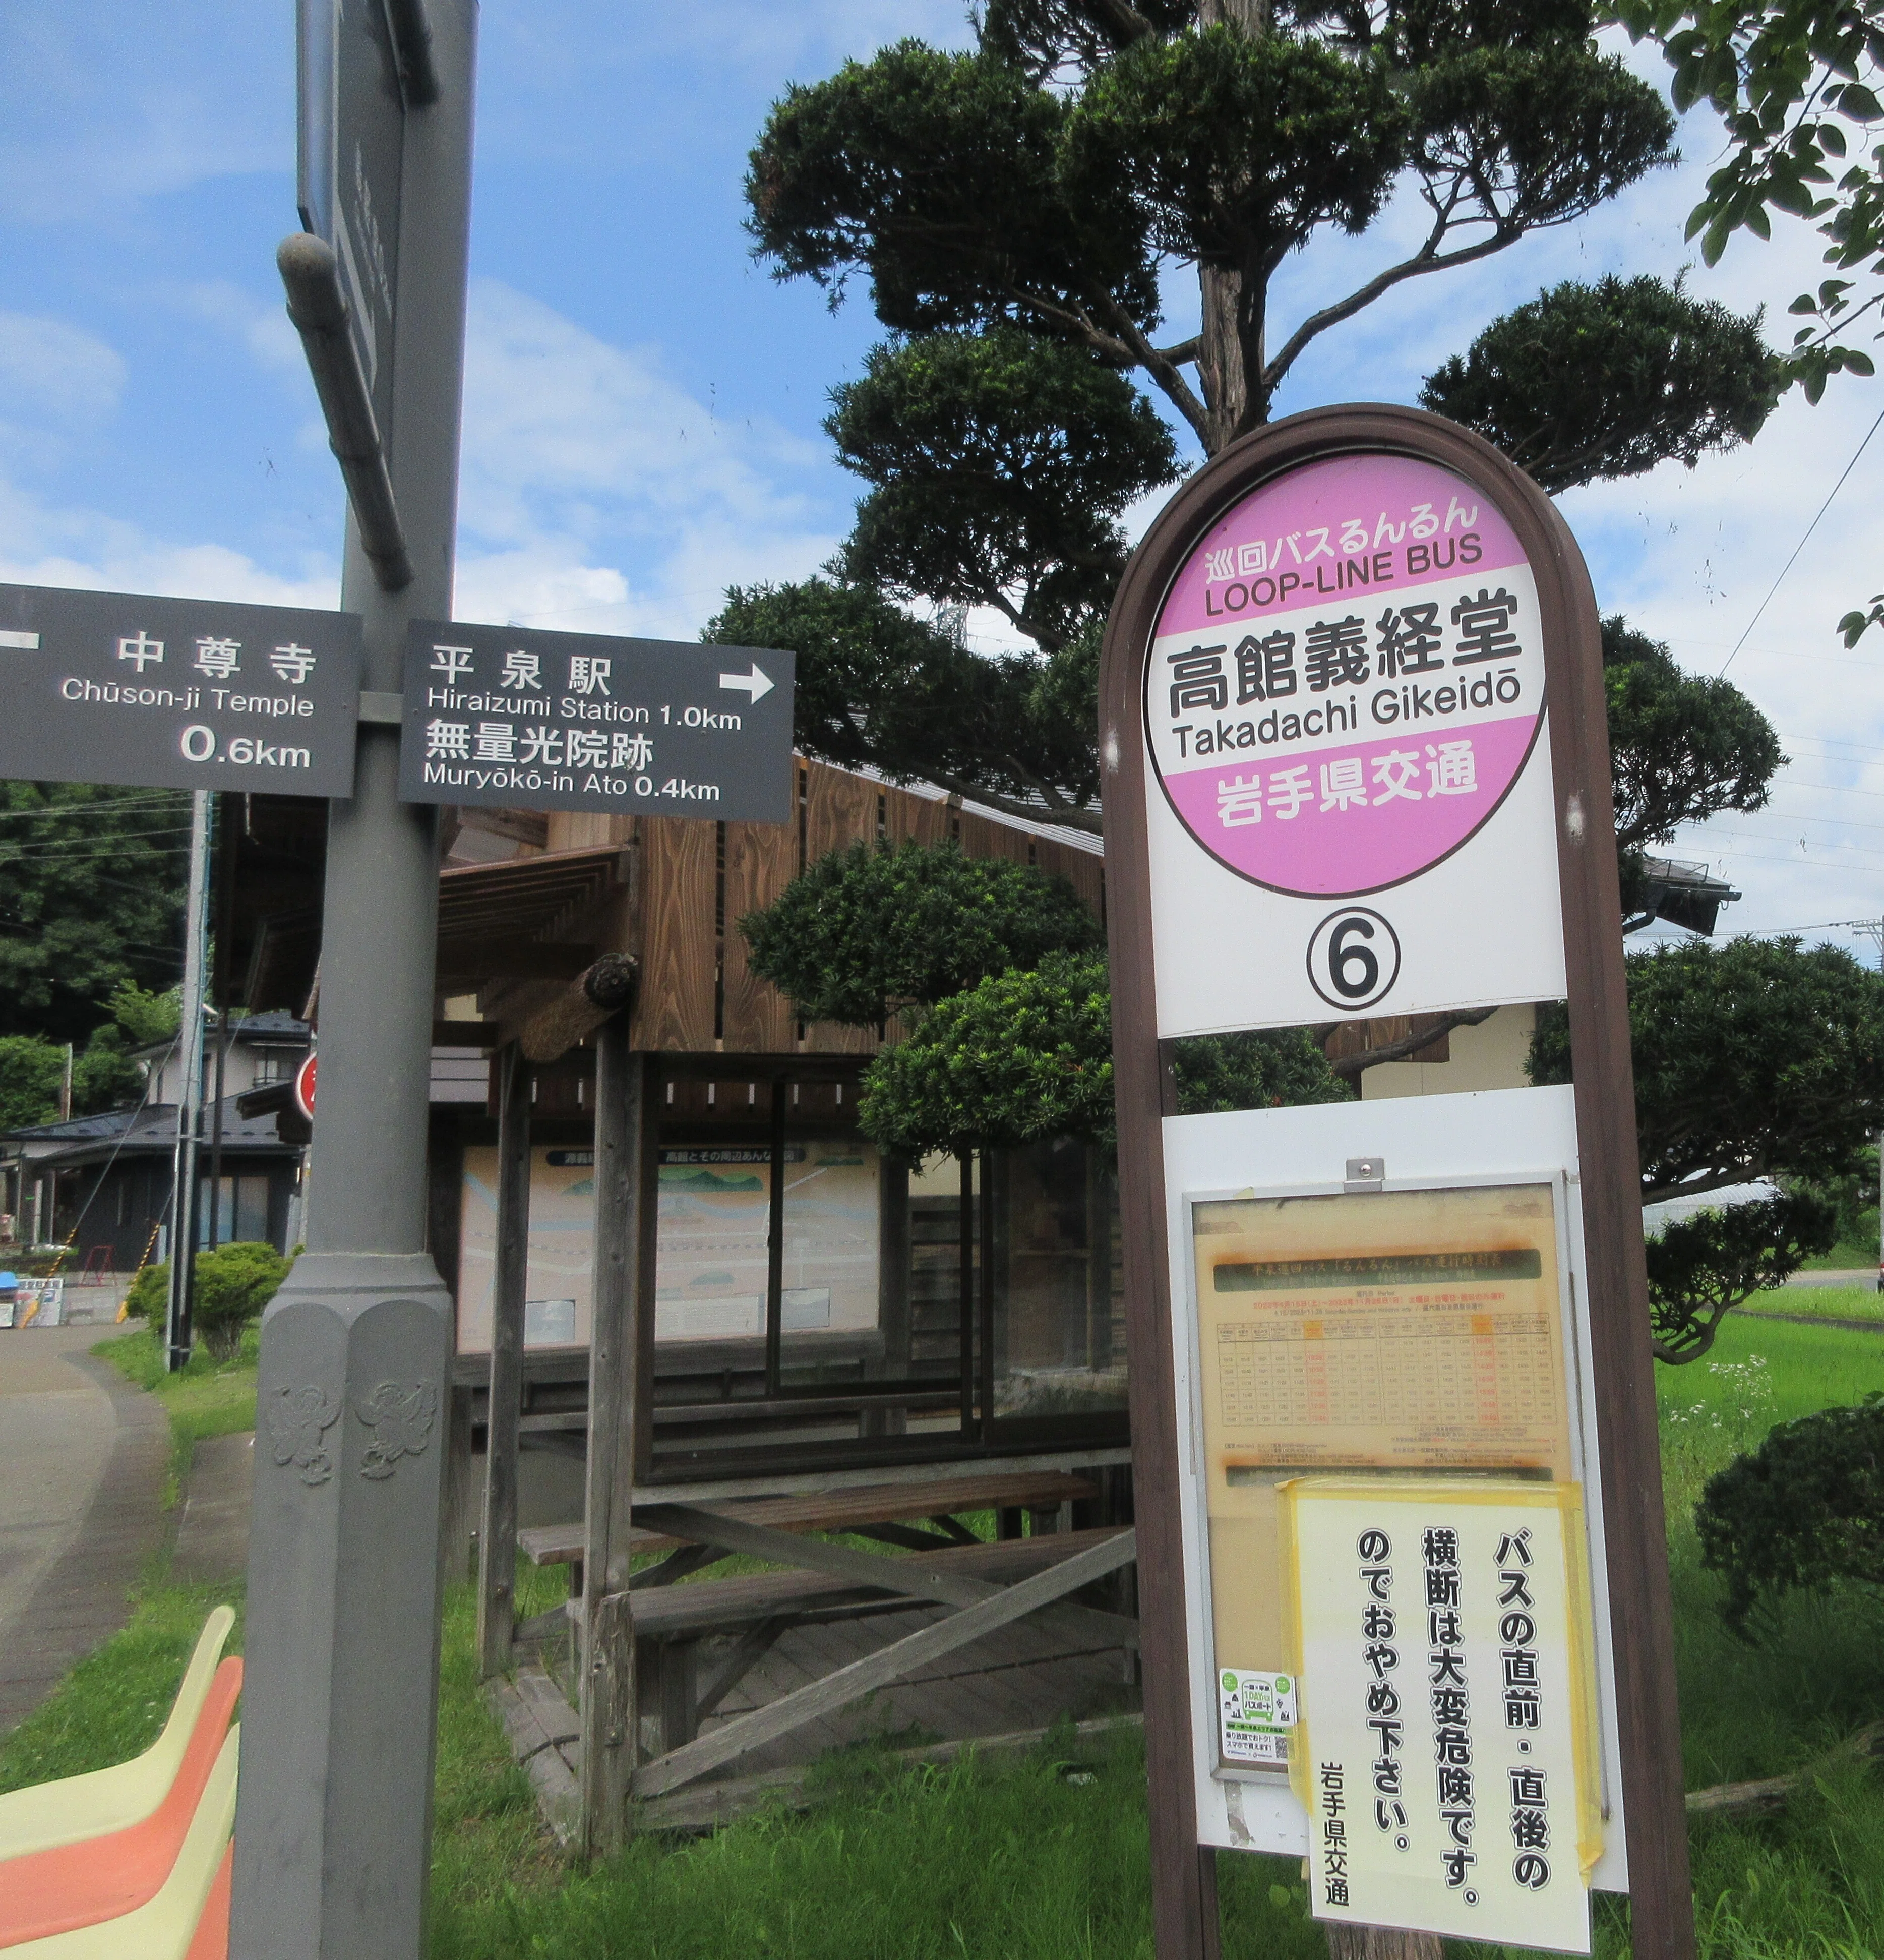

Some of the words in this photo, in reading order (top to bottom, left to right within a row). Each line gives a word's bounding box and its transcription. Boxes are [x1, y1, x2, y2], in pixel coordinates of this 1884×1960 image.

[1204, 496, 1478, 585] 巡回バスるんるん
[1205, 551, 1394, 617] LOOP-LINE
[1407, 532, 1483, 576] BUS
[117, 631, 316, 684] 中尊寺
[429, 645, 612, 696] 平泉駅
[1167, 587, 1523, 719] 高館義経堂
[62, 678, 200, 711] Chūson-ji
[210, 689, 314, 718] Temple
[428, 687, 550, 716] Hiraizumi
[560, 697, 649, 723] Station
[660, 705, 742, 730] 1.0km
[1171, 695, 1357, 759] Takadachi
[1371, 668, 1521, 725] Gikeidō
[180, 724, 311, 768] 0.6km
[423, 762, 574, 792] Muryōkō-in
[583, 773, 627, 795] Ato
[634, 776, 720, 801] 0.4km
[426, 718, 654, 772] 無量光院跡
[1216, 739, 1478, 828] 岩手県交通
[666, 1150, 795, 1162] 高館とその周辺あんな図
[1357, 1527, 1410, 1852] のでおやめ下さい。
[1421, 1526, 1480, 1908] 横断は大変危険です。
[1493, 1527, 1551, 1891] バスの直前・直後の
[1320, 1761, 1350, 1907] 岩手県交通
